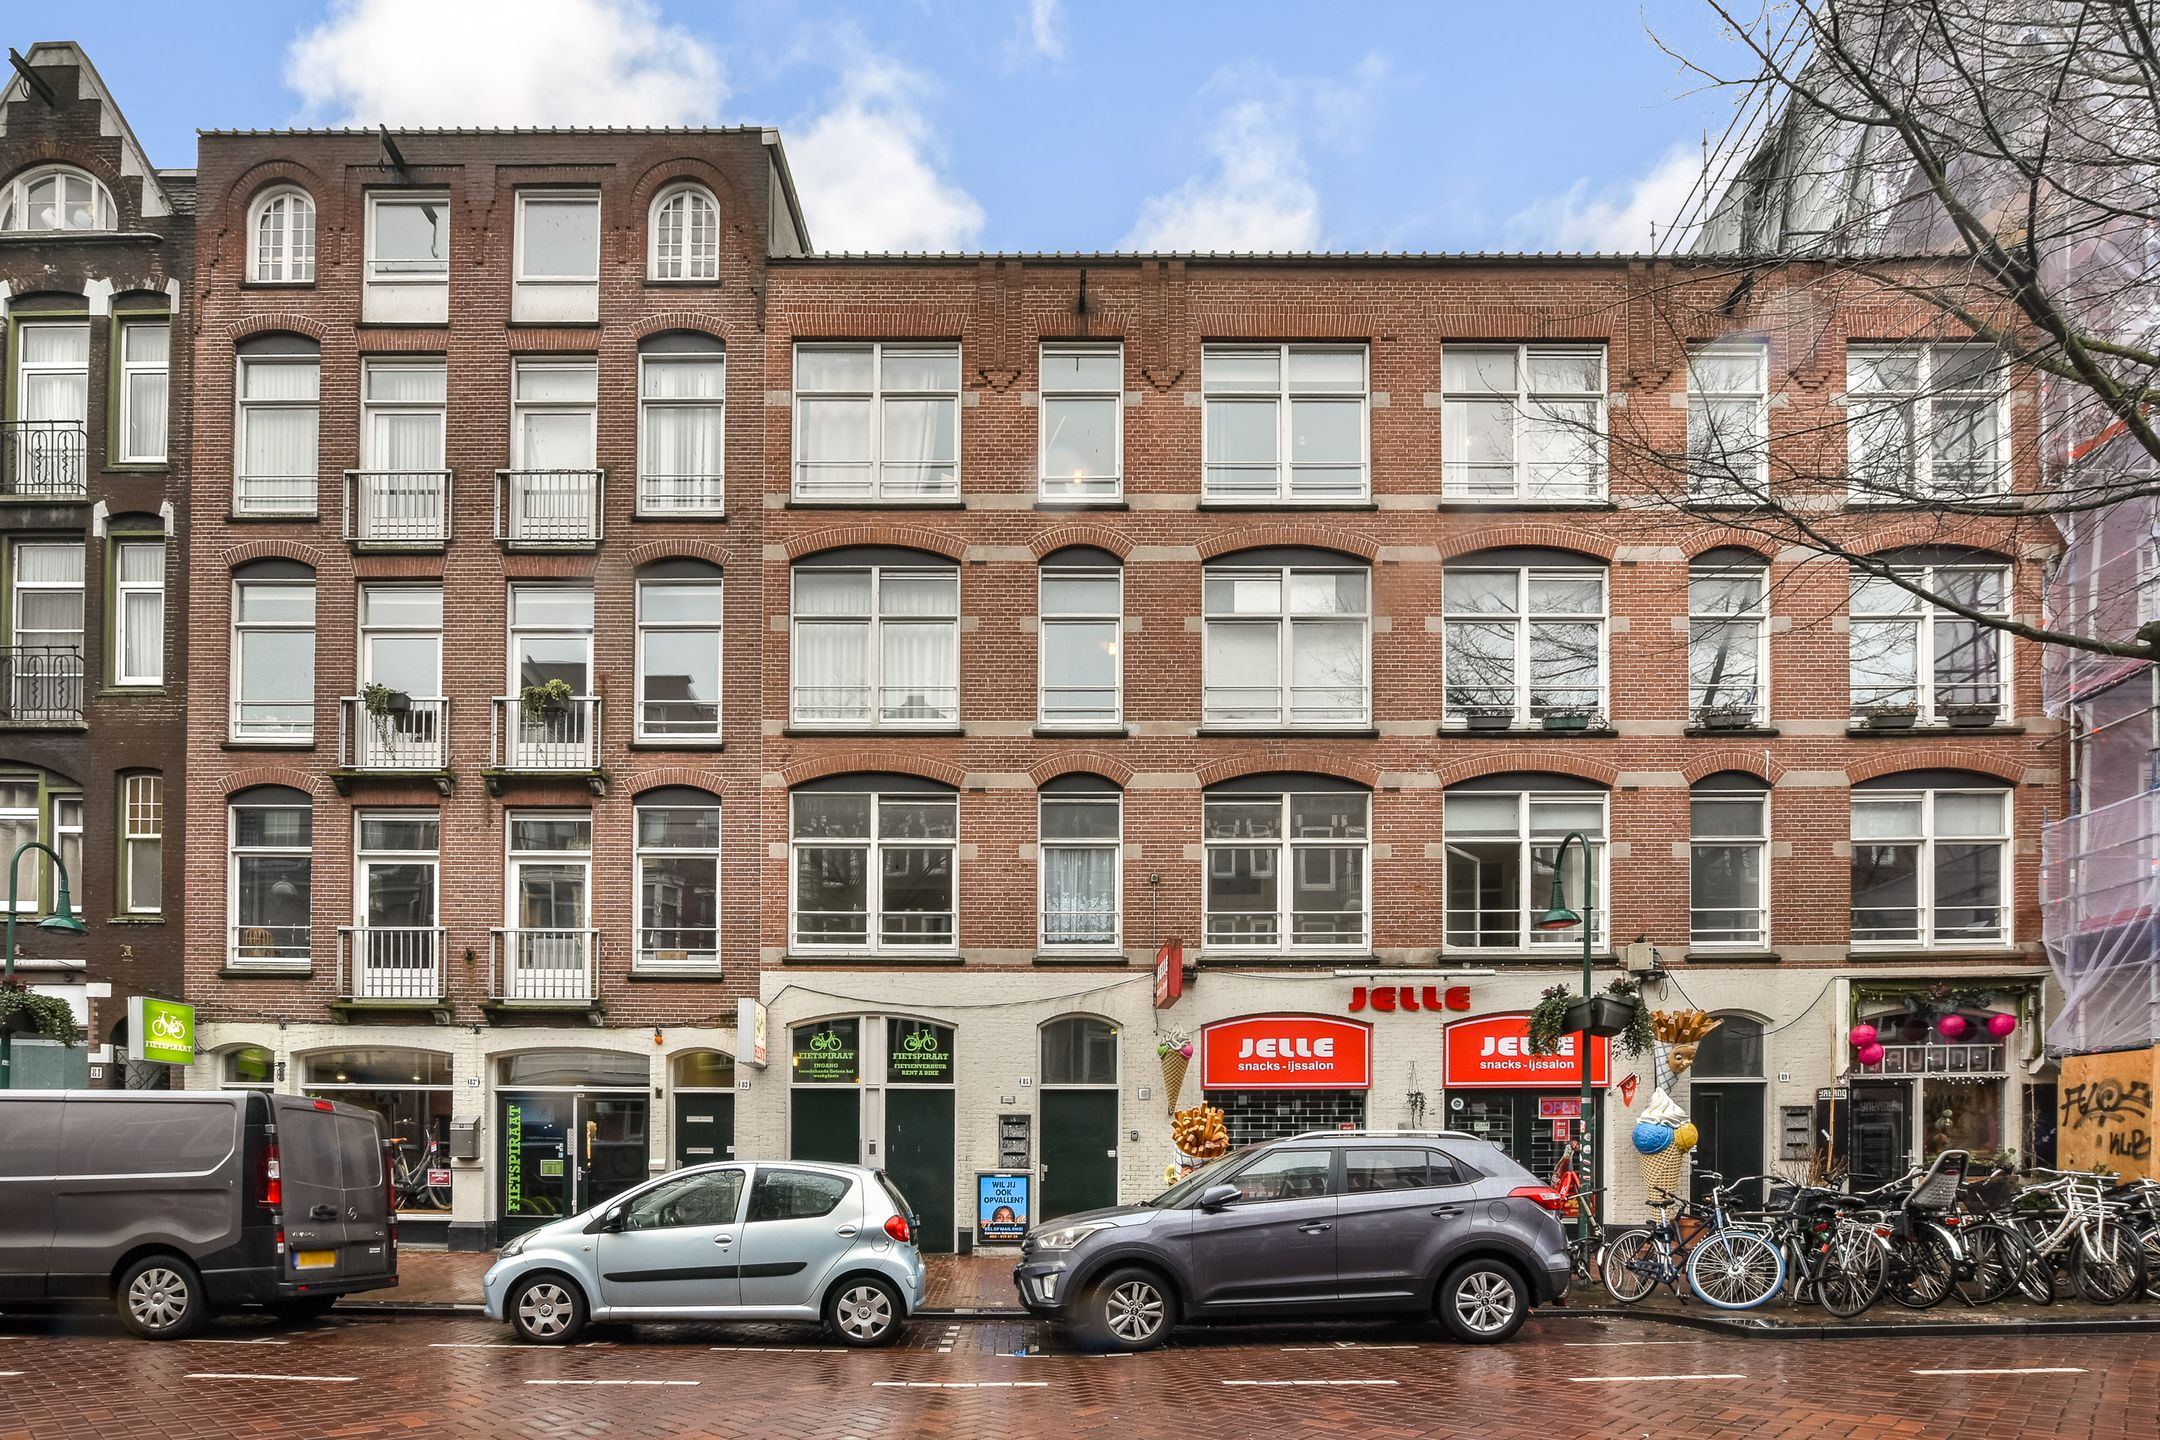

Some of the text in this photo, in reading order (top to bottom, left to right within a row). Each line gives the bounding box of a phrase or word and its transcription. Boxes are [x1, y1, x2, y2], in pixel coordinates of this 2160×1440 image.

[1348, 986, 1471, 1012] JELLE
[145, 1040, 193, 1052] FIETSPIRAAT
[1238, 1037, 1334, 1059] JELLE
[1480, 1036, 1575, 1057] JELE
[799, 1052, 854, 1060] FIETSPIRAAT
[892, 1052, 949, 1061] FIETSPIRAAT
[91, 1068, 101, 1077] 81
[508, 1105, 521, 1211] FIETSPIRAAT
[984, 1196, 1024, 1204] OPVALLEN?
